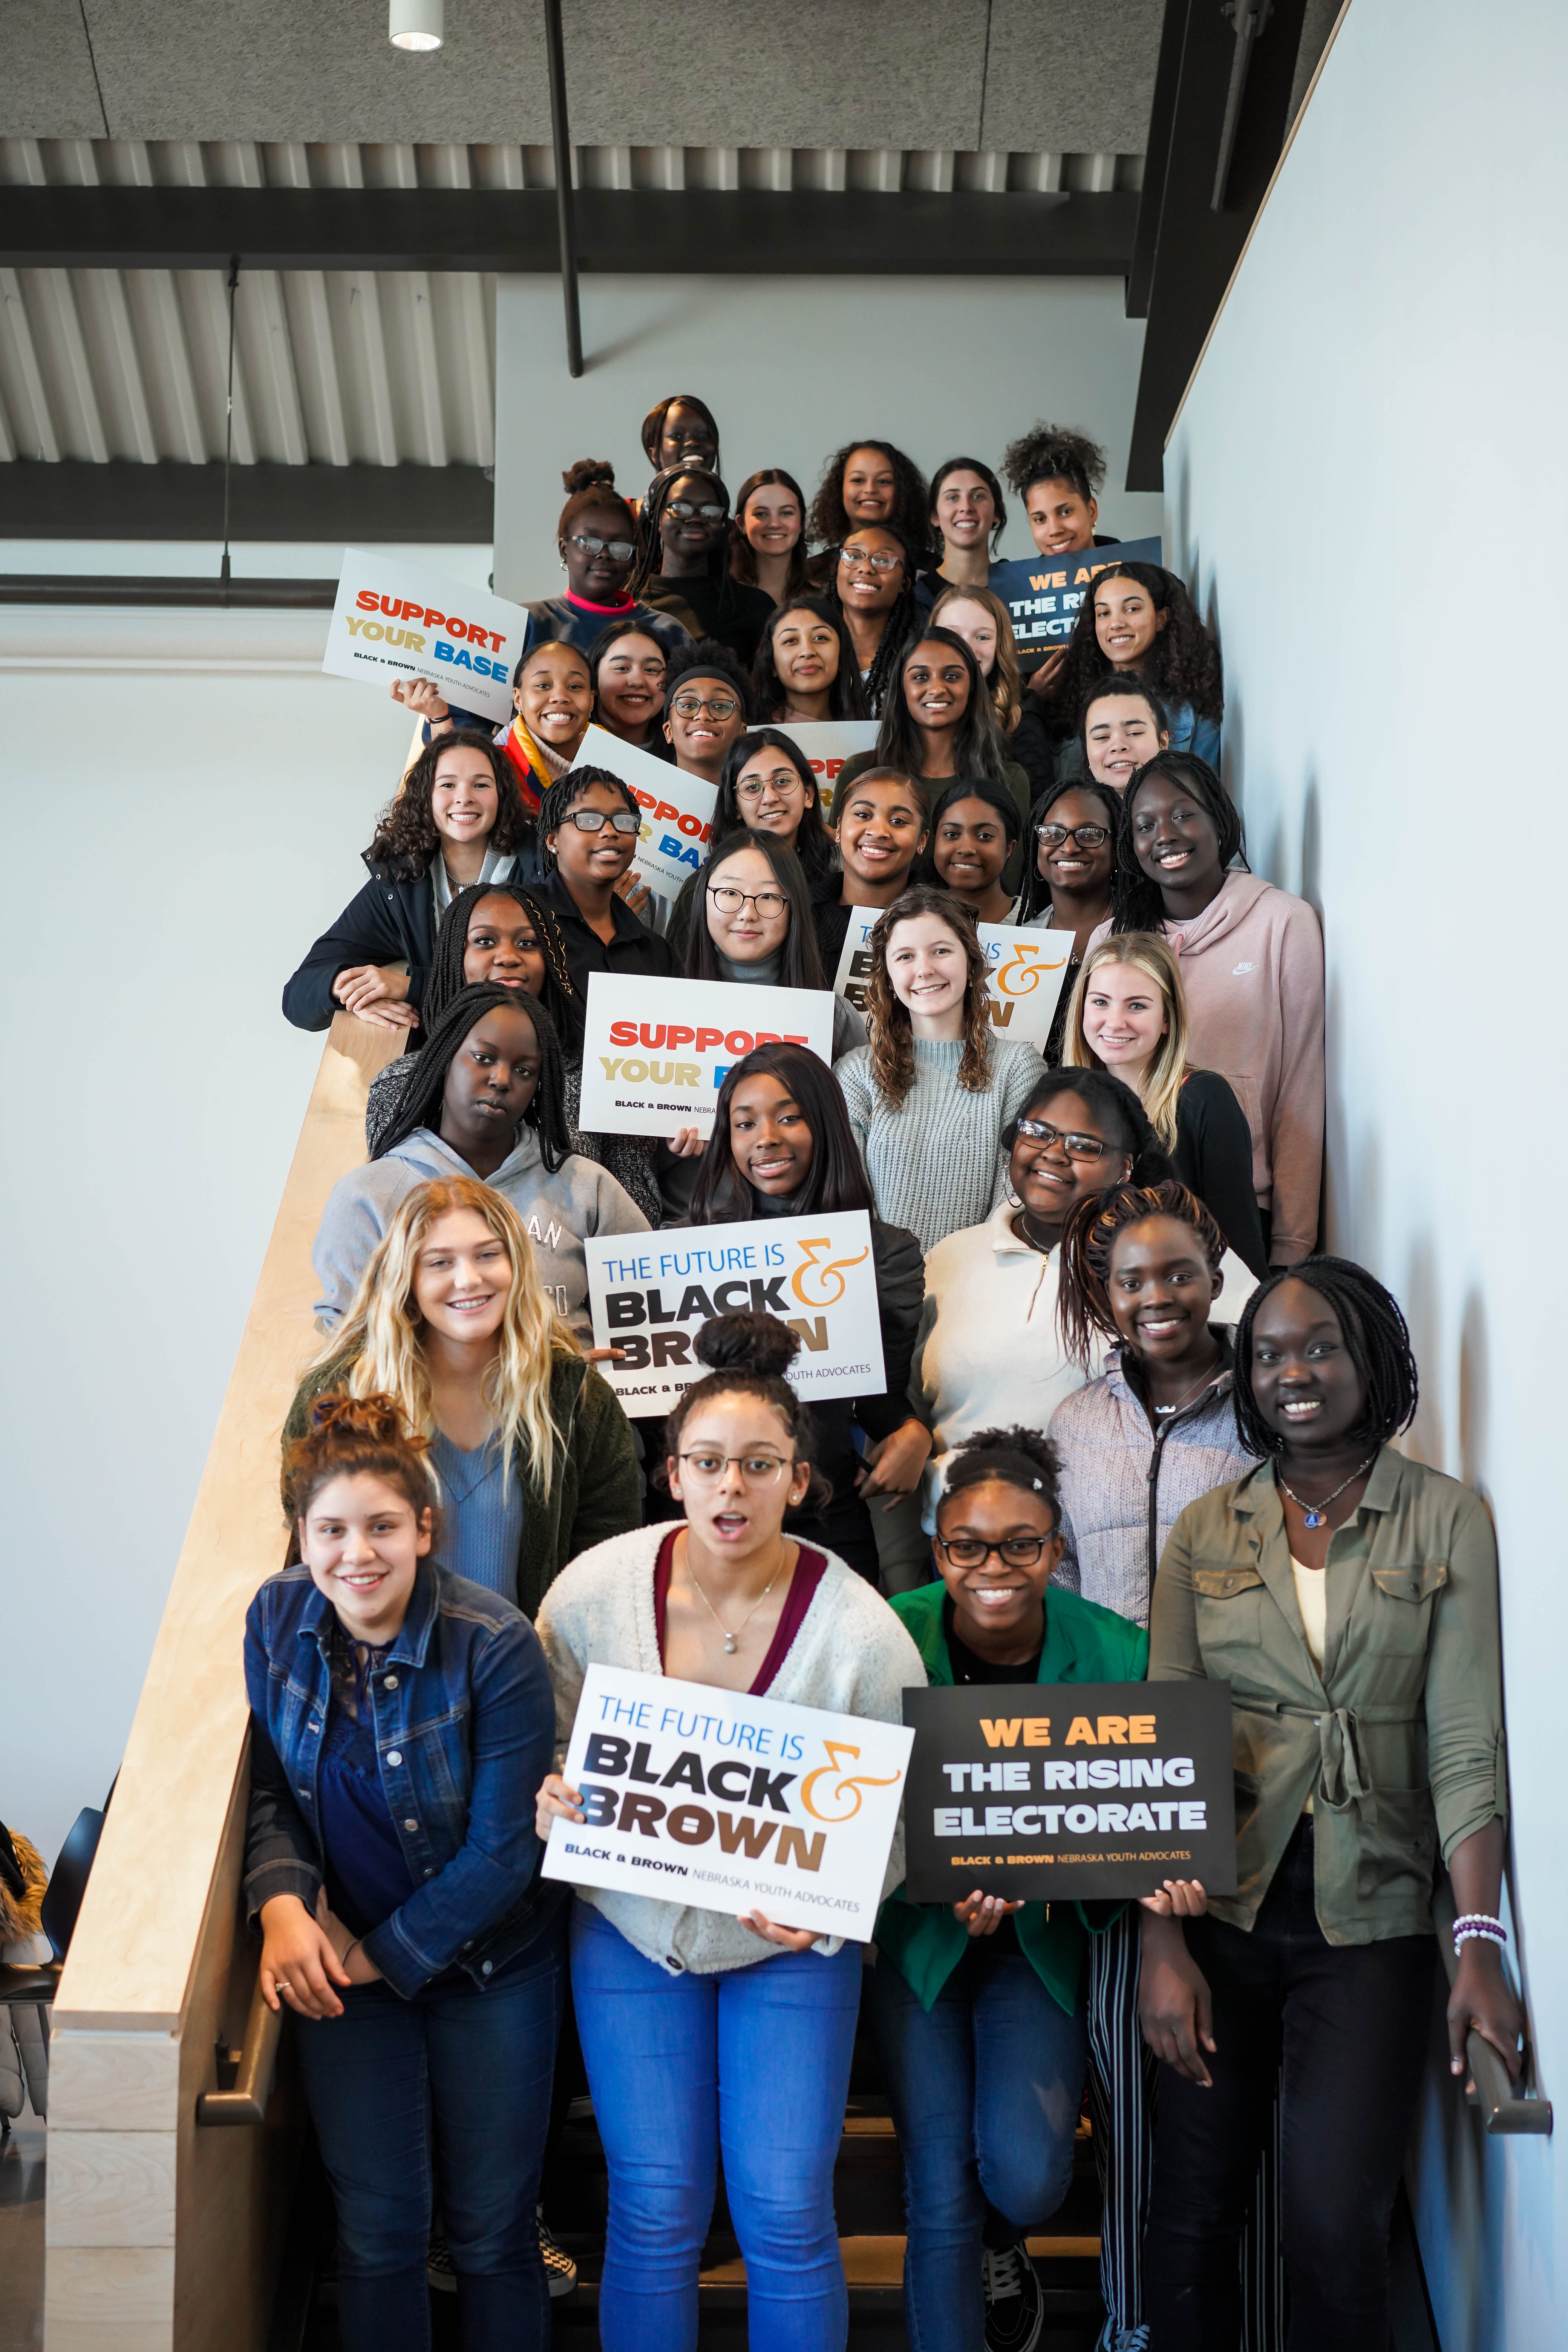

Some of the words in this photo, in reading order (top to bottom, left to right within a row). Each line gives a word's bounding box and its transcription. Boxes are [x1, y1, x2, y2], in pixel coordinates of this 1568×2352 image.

[1029, 571, 1067, 591] WE
[356, 590, 507, 654] SUPPORT
[1009, 596, 1056, 617] THE
[345, 616, 426, 654] YOUR
[434, 640, 509, 684] BASE
[354, 652, 378, 662] BLACK
[387, 660, 415, 671] BROWN
[417, 668, 444, 680] NEBRASKA
[445, 676, 462, 687] YOUTH
[462, 684, 490, 698] ADVOCATES
[637, 856, 664, 874] NEBRASKA
[666, 871, 684, 884] YOUTH
[985, 942, 1001, 959] IS
[1236, 962, 1253, 971] NIKE
[997, 944, 1066, 996] &
[598, 1057, 701, 1087] YOUR
[615, 1100, 645, 1109] BLACK
[657, 1104, 691, 1112] BROWN
[602, 1257, 652, 1282] THE
[660, 1246, 756, 1277] FUTURE
[765, 1243, 785, 1265] IS
[605, 1276, 791, 1329] BLACK
[792, 1237, 869, 1307] &
[786, 1370, 813, 1381] OUTH
[816, 1364, 871, 1378] ADVOCATES
[616, 1386, 657, 1396] BLACK
[599, 1695, 653, 1729] THE
[660, 1708, 773, 1755] FUTURE
[780, 1733, 805, 1761] IS
[980, 1717, 1051, 1747] WE
[1064, 1715, 1156, 1746] ARE
[583, 1732, 798, 1813] BLACK
[801, 1740, 901, 1822] &
[942, 1762, 1031, 1792] THE
[1044, 1757, 1195, 1790] RISING
[577, 1782, 827, 1872] BROWN
[934, 1801, 1207, 1836] ELECTORATE
[951, 1856, 991, 1866] BLACK
[995, 1856, 1003, 1864] &
[1007, 1854, 1054, 1865] BROWN
[1057, 1853, 1104, 1863] NEBRASKA
[1106, 1852, 1136, 1862] YOUTH
[1139, 1850, 1191, 1861] ADVOCATES
[565, 1843, 610, 1860] BLACK
[617, 1854, 626, 1862] &
[631, 1856, 688, 1877] BROWN
[692, 1868, 750, 1890] NEBRASKA
[754, 1882, 792, 1900] YOUTH
[794, 1889, 860, 1913] ADVOCATES
